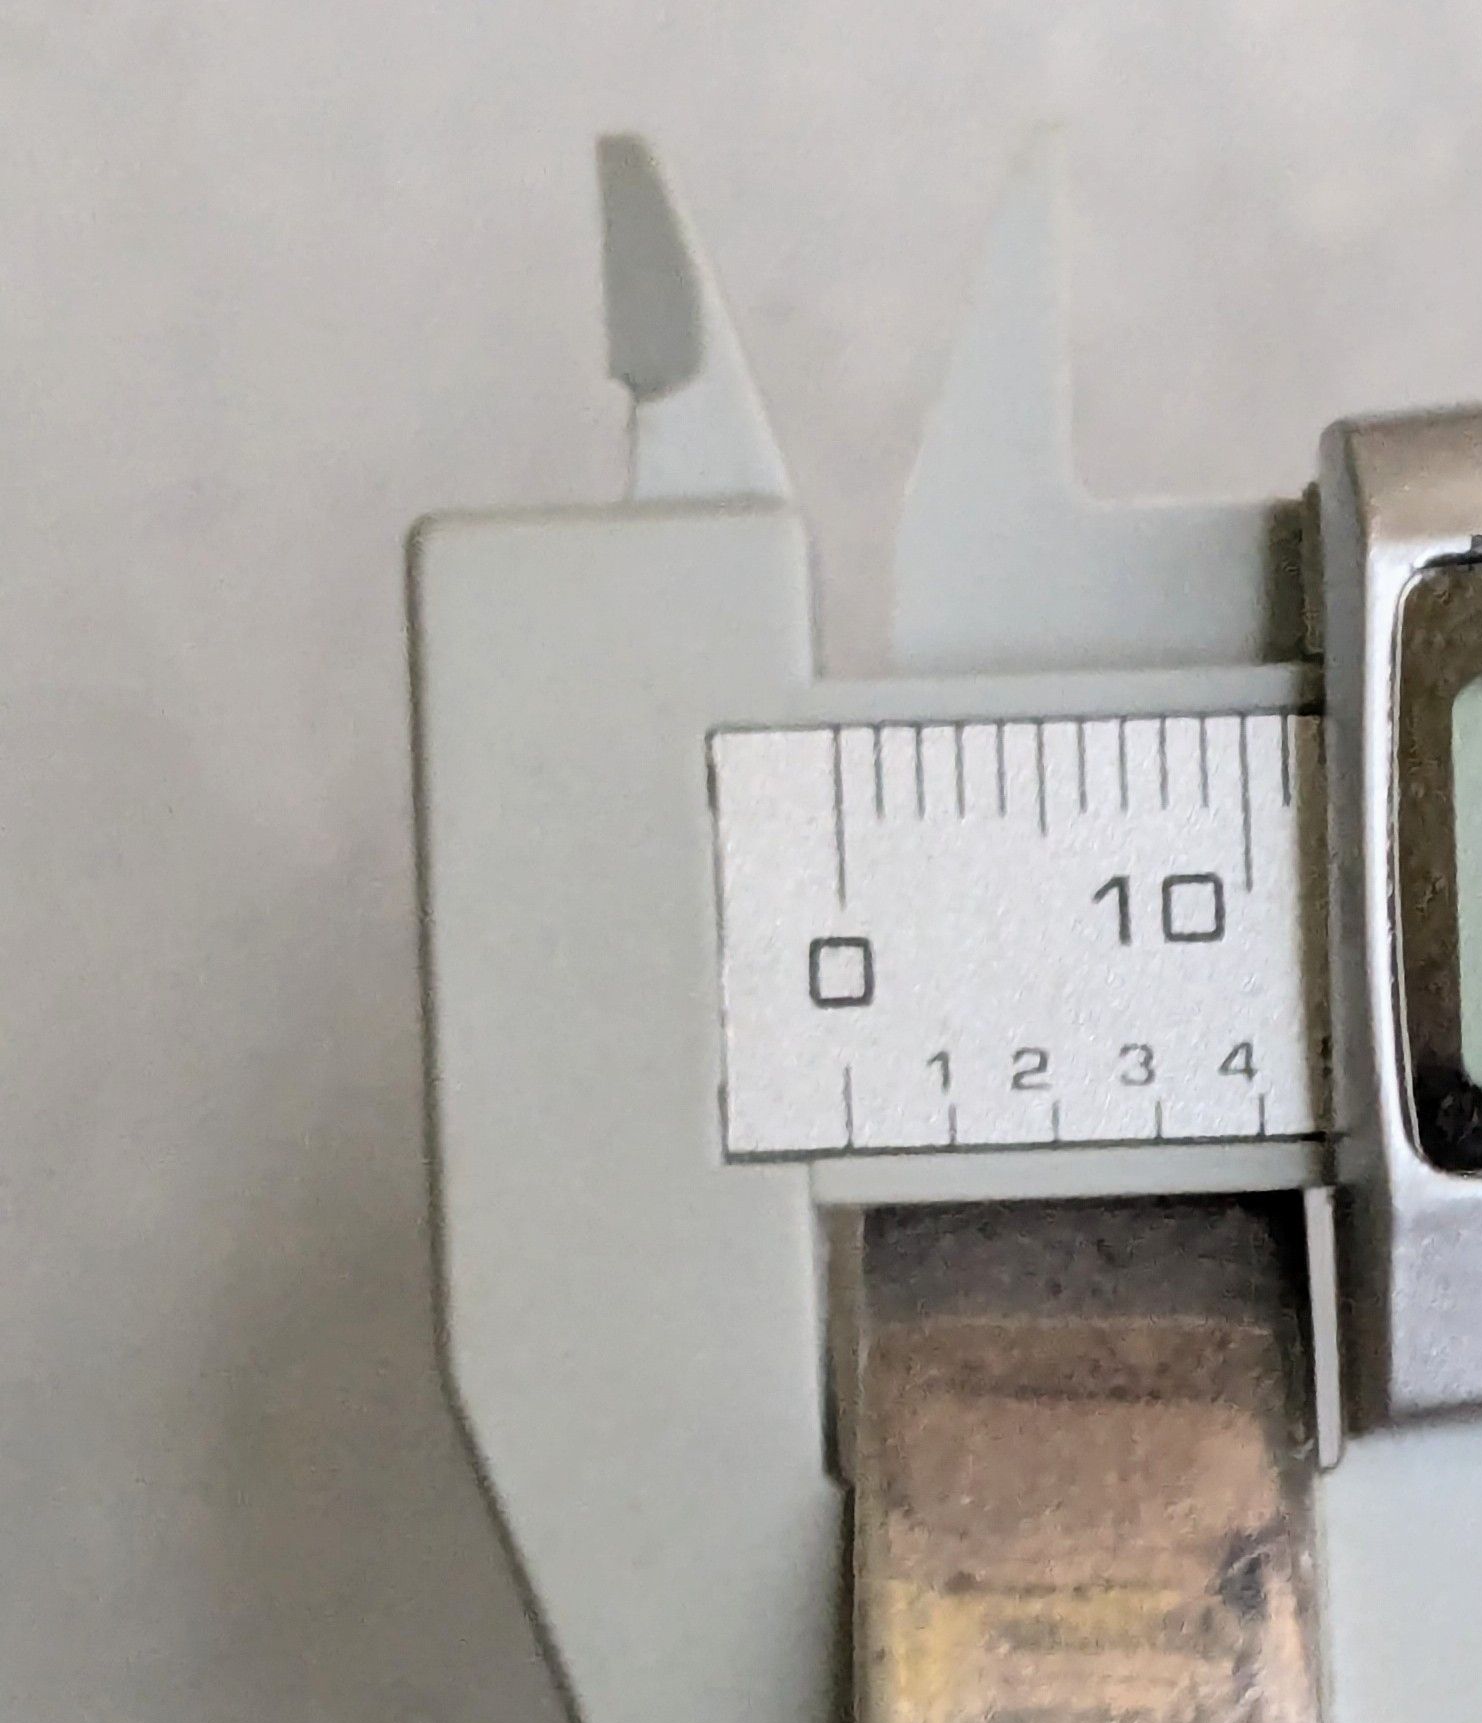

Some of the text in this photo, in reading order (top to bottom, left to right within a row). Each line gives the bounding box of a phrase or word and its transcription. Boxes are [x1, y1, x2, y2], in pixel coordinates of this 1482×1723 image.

[1092, 873, 1226, 946] 10
[809, 936, 875, 1008] 0
[927, 1041, 1257, 1093] 1 2 3 4
